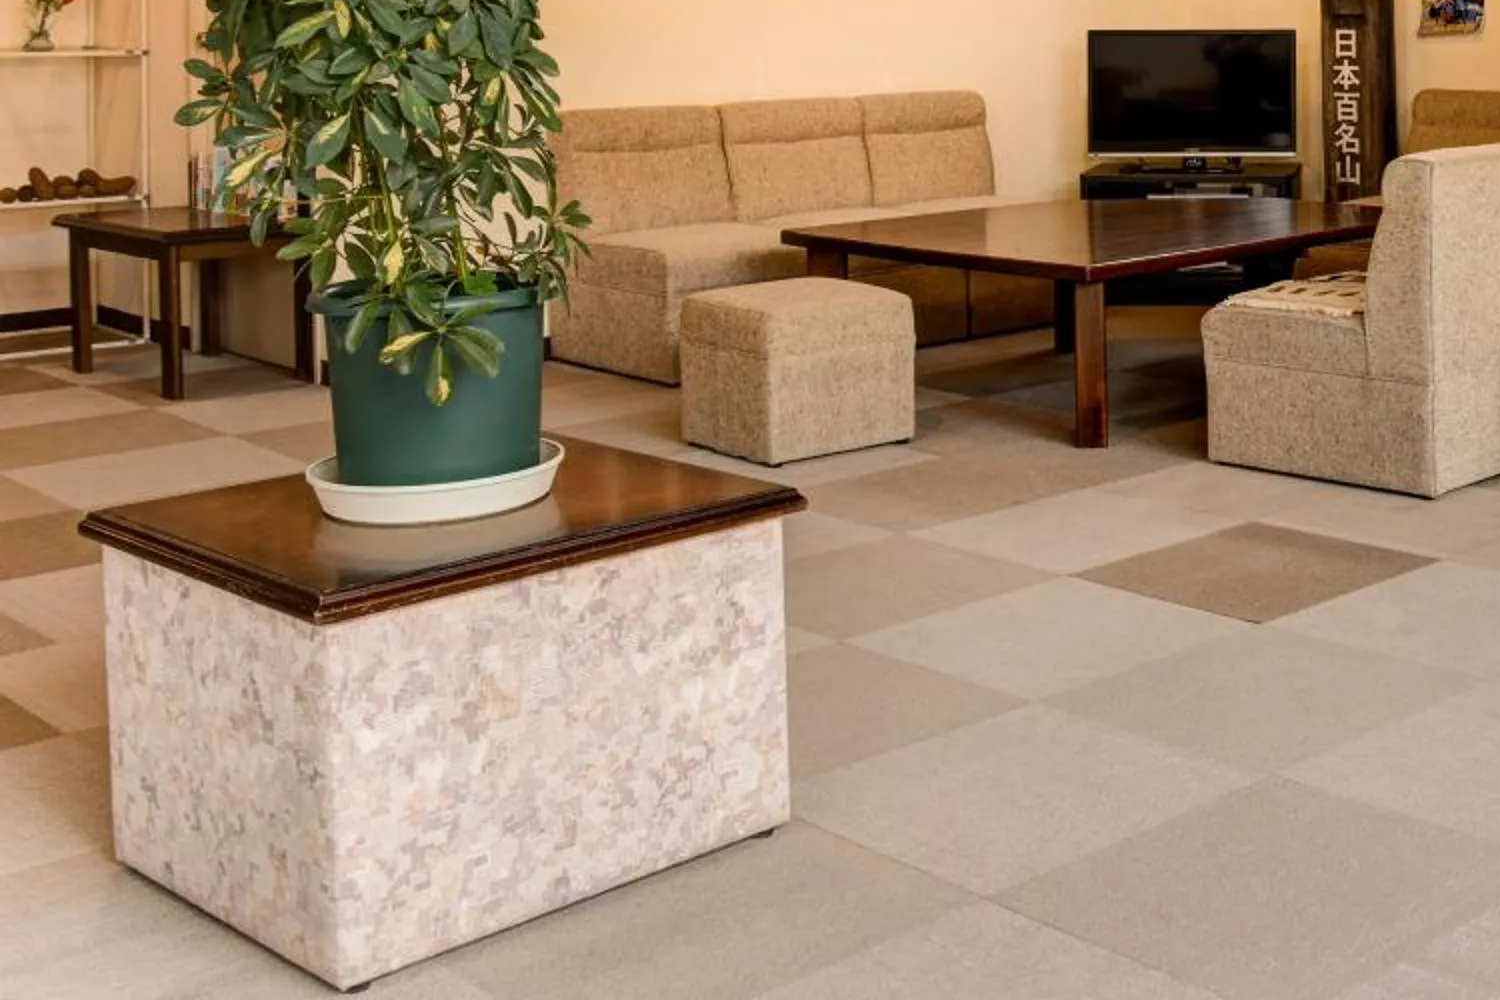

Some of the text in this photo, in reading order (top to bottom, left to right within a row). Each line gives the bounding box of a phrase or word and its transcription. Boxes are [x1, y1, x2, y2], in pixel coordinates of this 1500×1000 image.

[1332, 28, 1361, 185] 日本百名山
